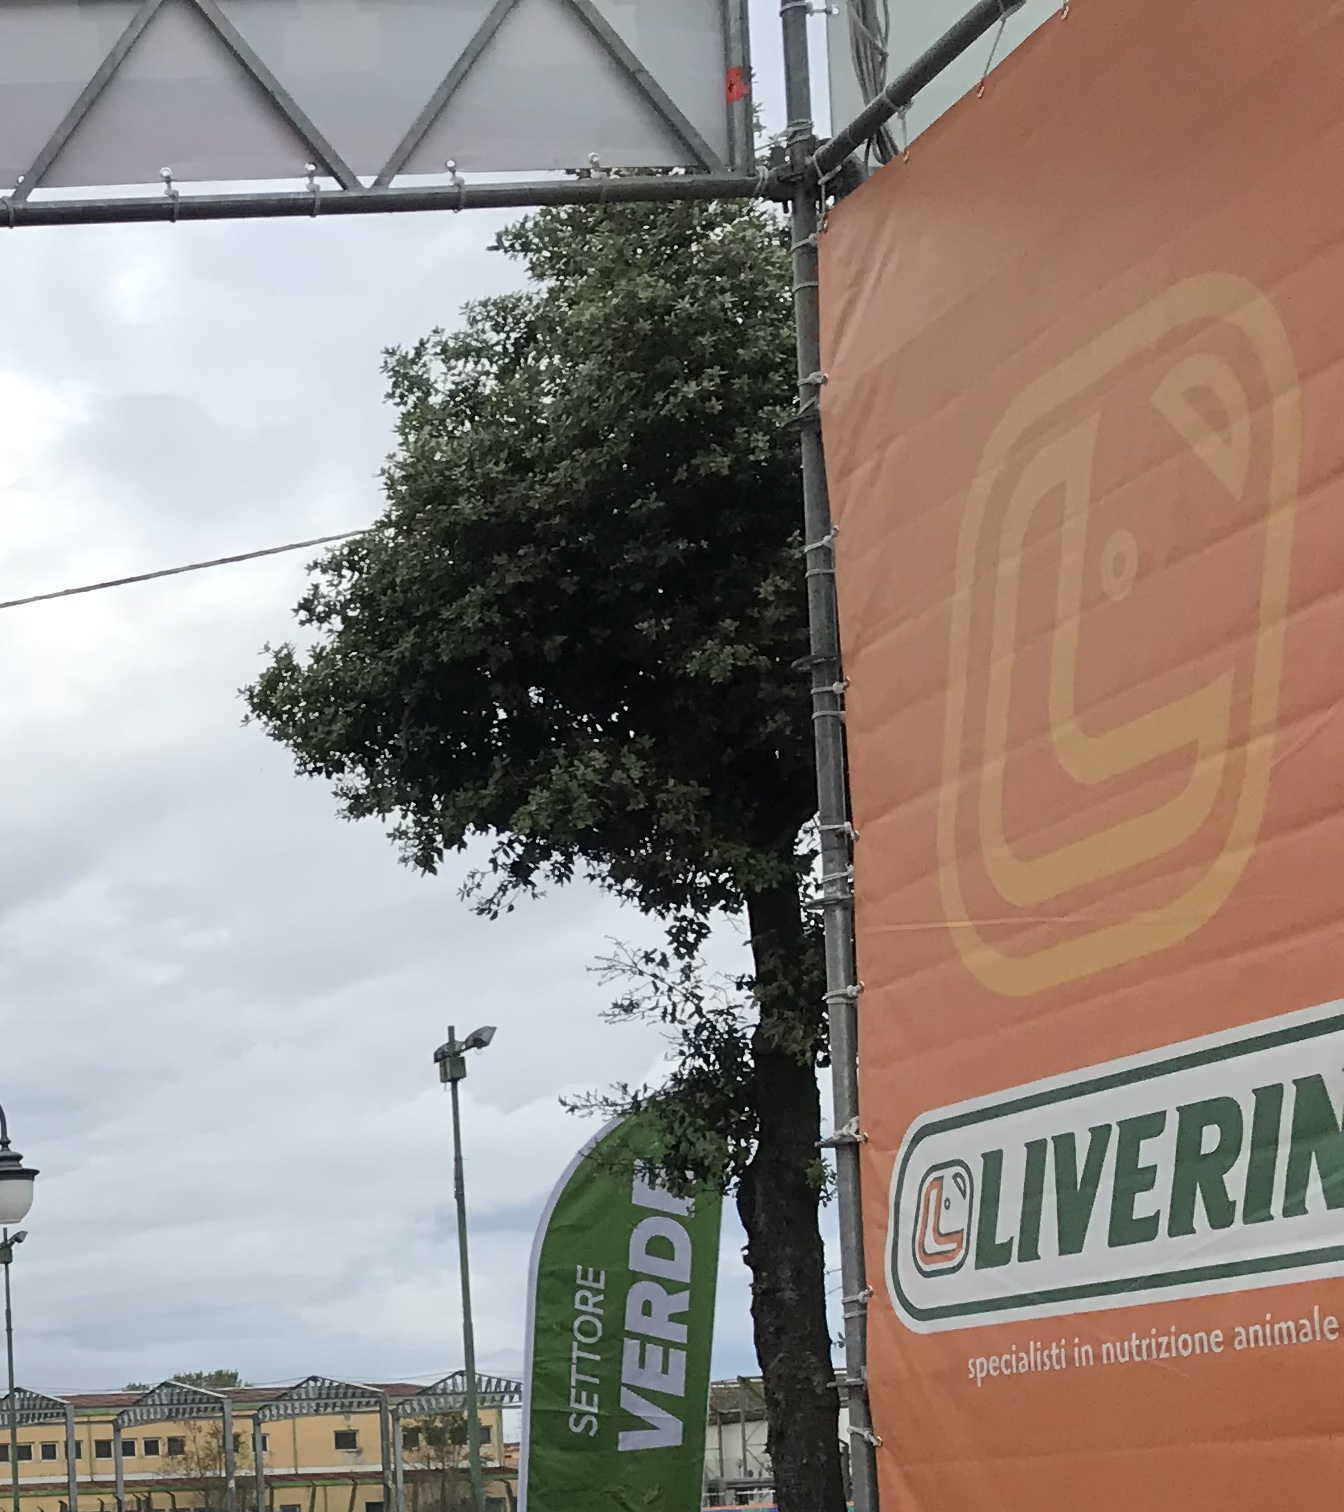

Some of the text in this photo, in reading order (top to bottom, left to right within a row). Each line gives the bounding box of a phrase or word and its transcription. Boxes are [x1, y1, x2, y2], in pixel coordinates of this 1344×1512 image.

[568, 1264, 606, 1438] SETTORE
[967, 1304, 1341, 1388] specialisti in nutrizione animale
